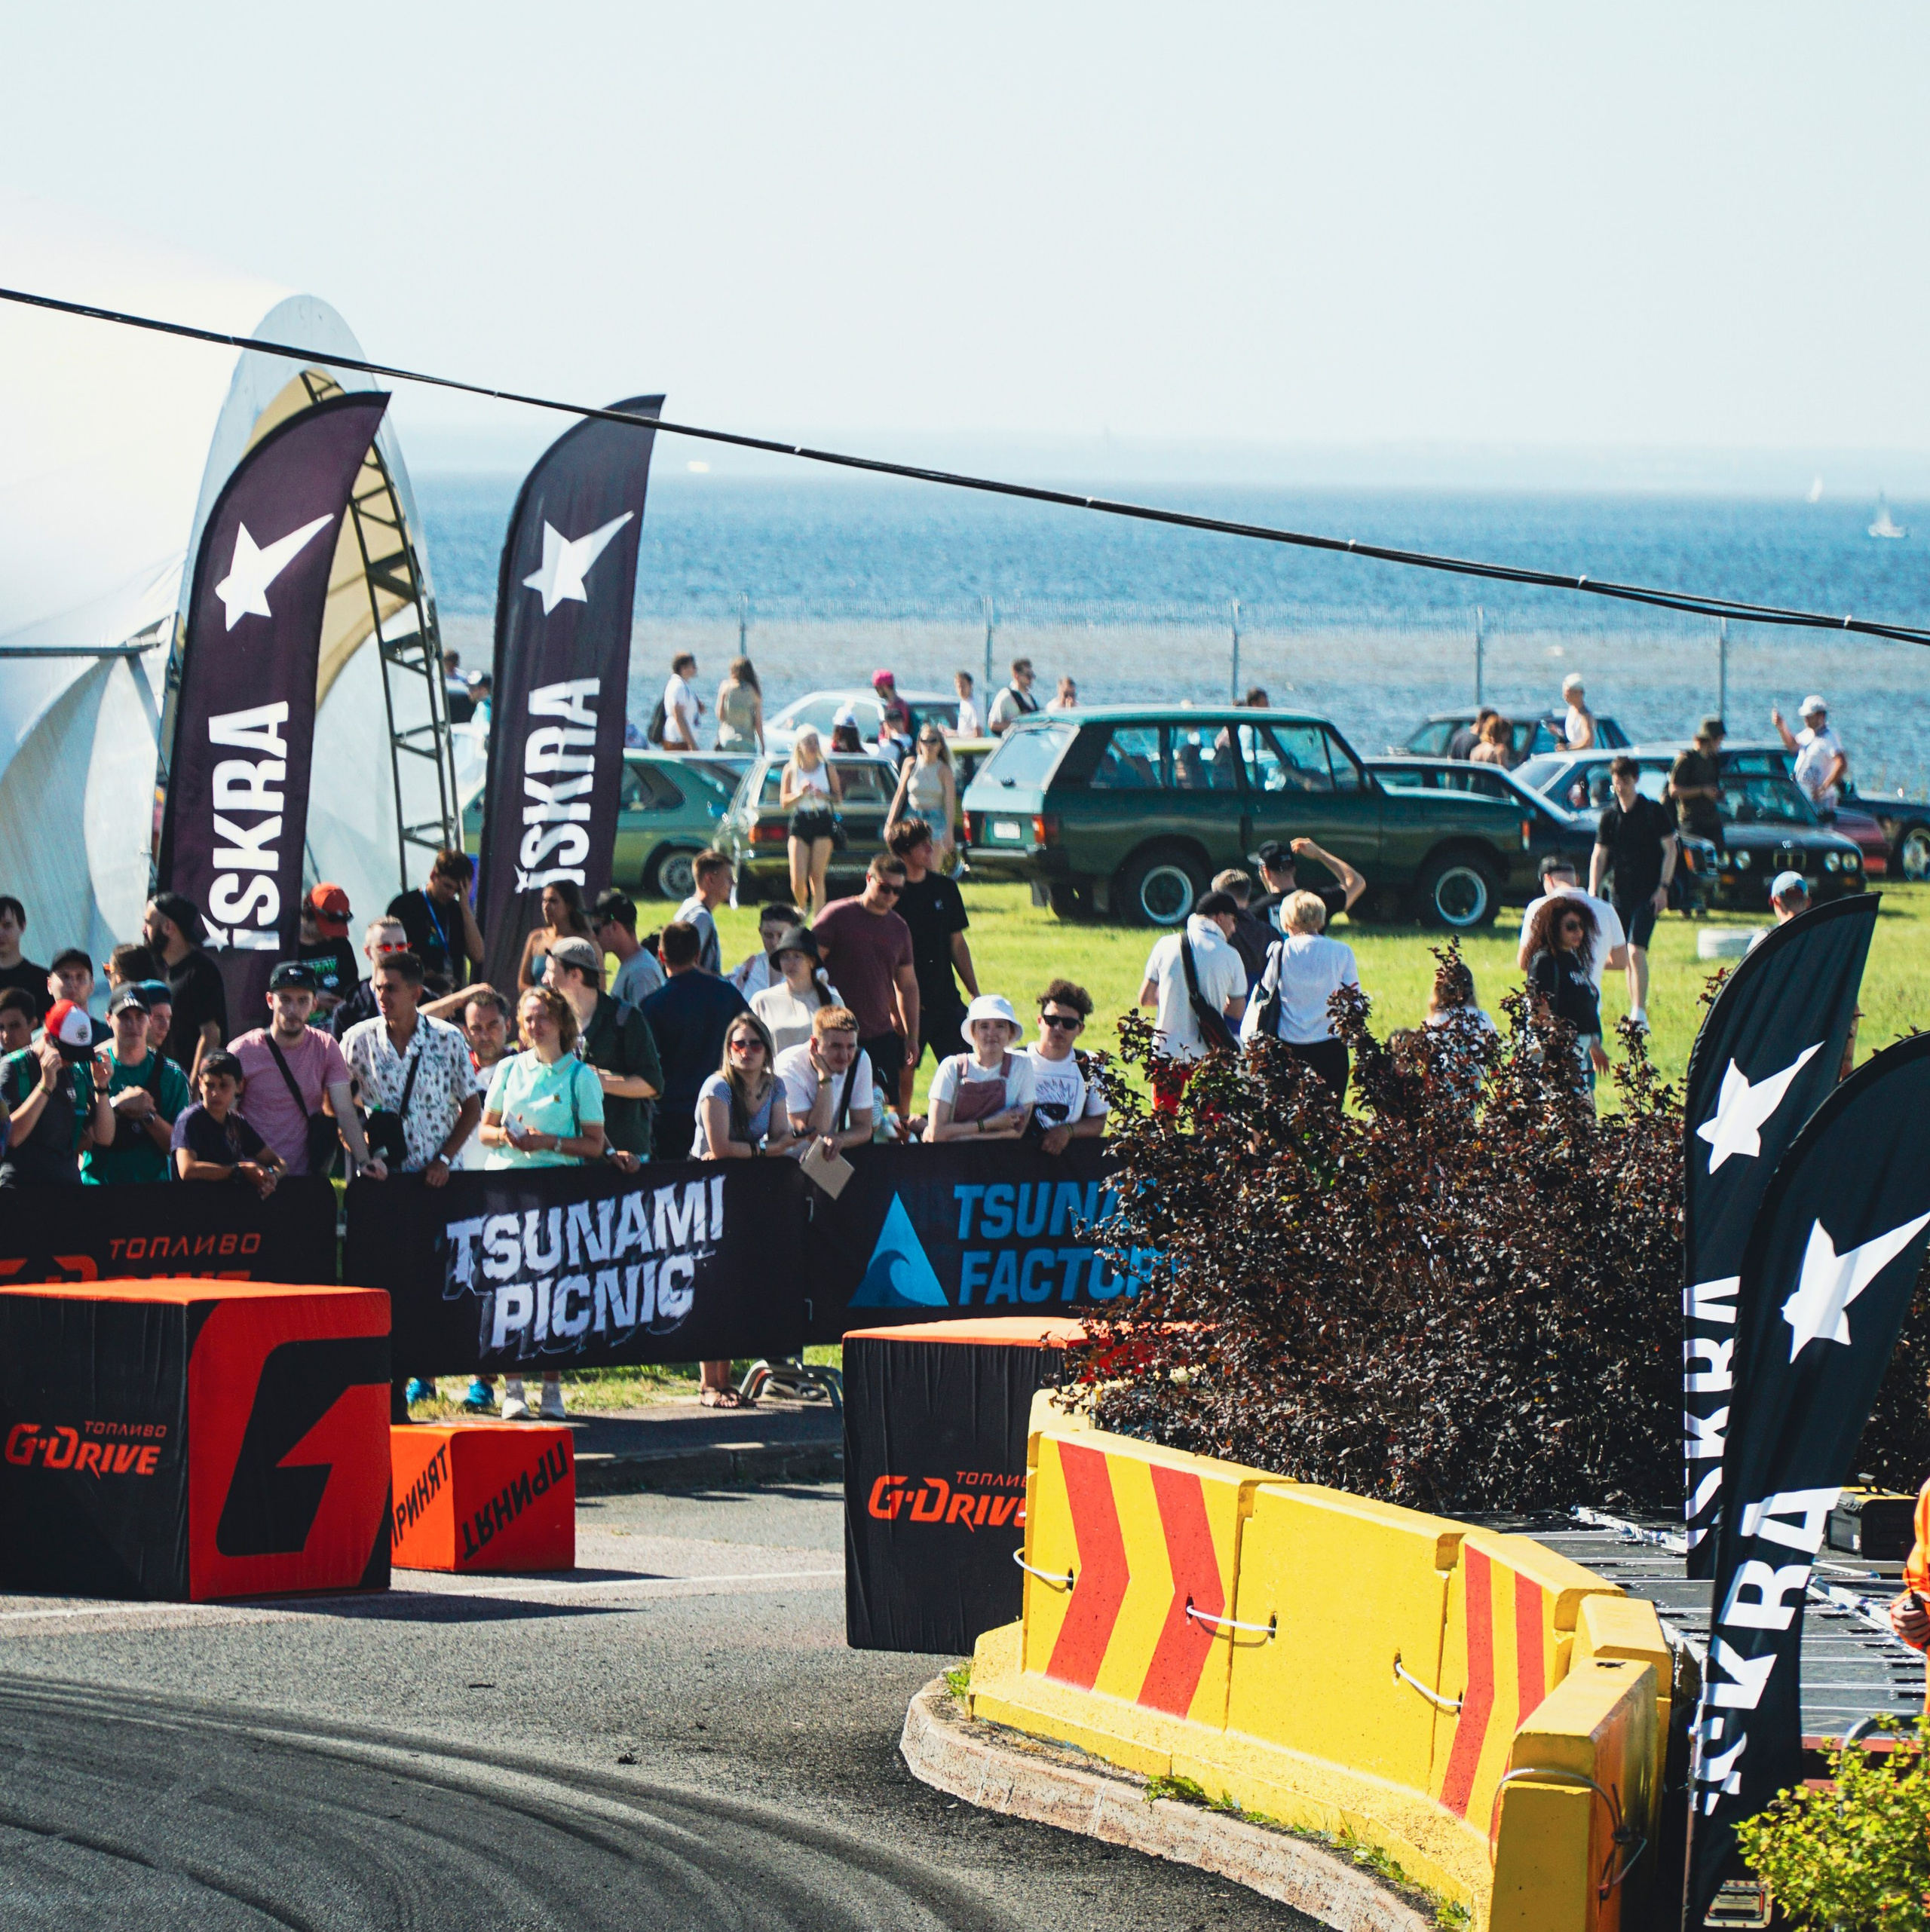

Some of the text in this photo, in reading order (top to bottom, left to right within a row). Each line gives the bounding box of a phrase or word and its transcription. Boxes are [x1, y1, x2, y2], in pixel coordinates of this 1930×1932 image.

[200, 700, 289, 952] ISKRA
[109, 1233, 261, 1260] ТОПЛИВО
[446, 1174, 726, 1283] TSUNAMI
[953, 1180, 1167, 1241] TSUN
[490, 1254, 696, 1349] PICNIC
[957, 1245, 1189, 1306] FACTOR
[84, 1420, 167, 1438] ТОПЛИВО
[1683, 1275, 1741, 1551] SKRA
[461, 1441, 569, 1562] ПРИНЯТ
[956, 1471, 1027, 1488] ТОПЛИ
